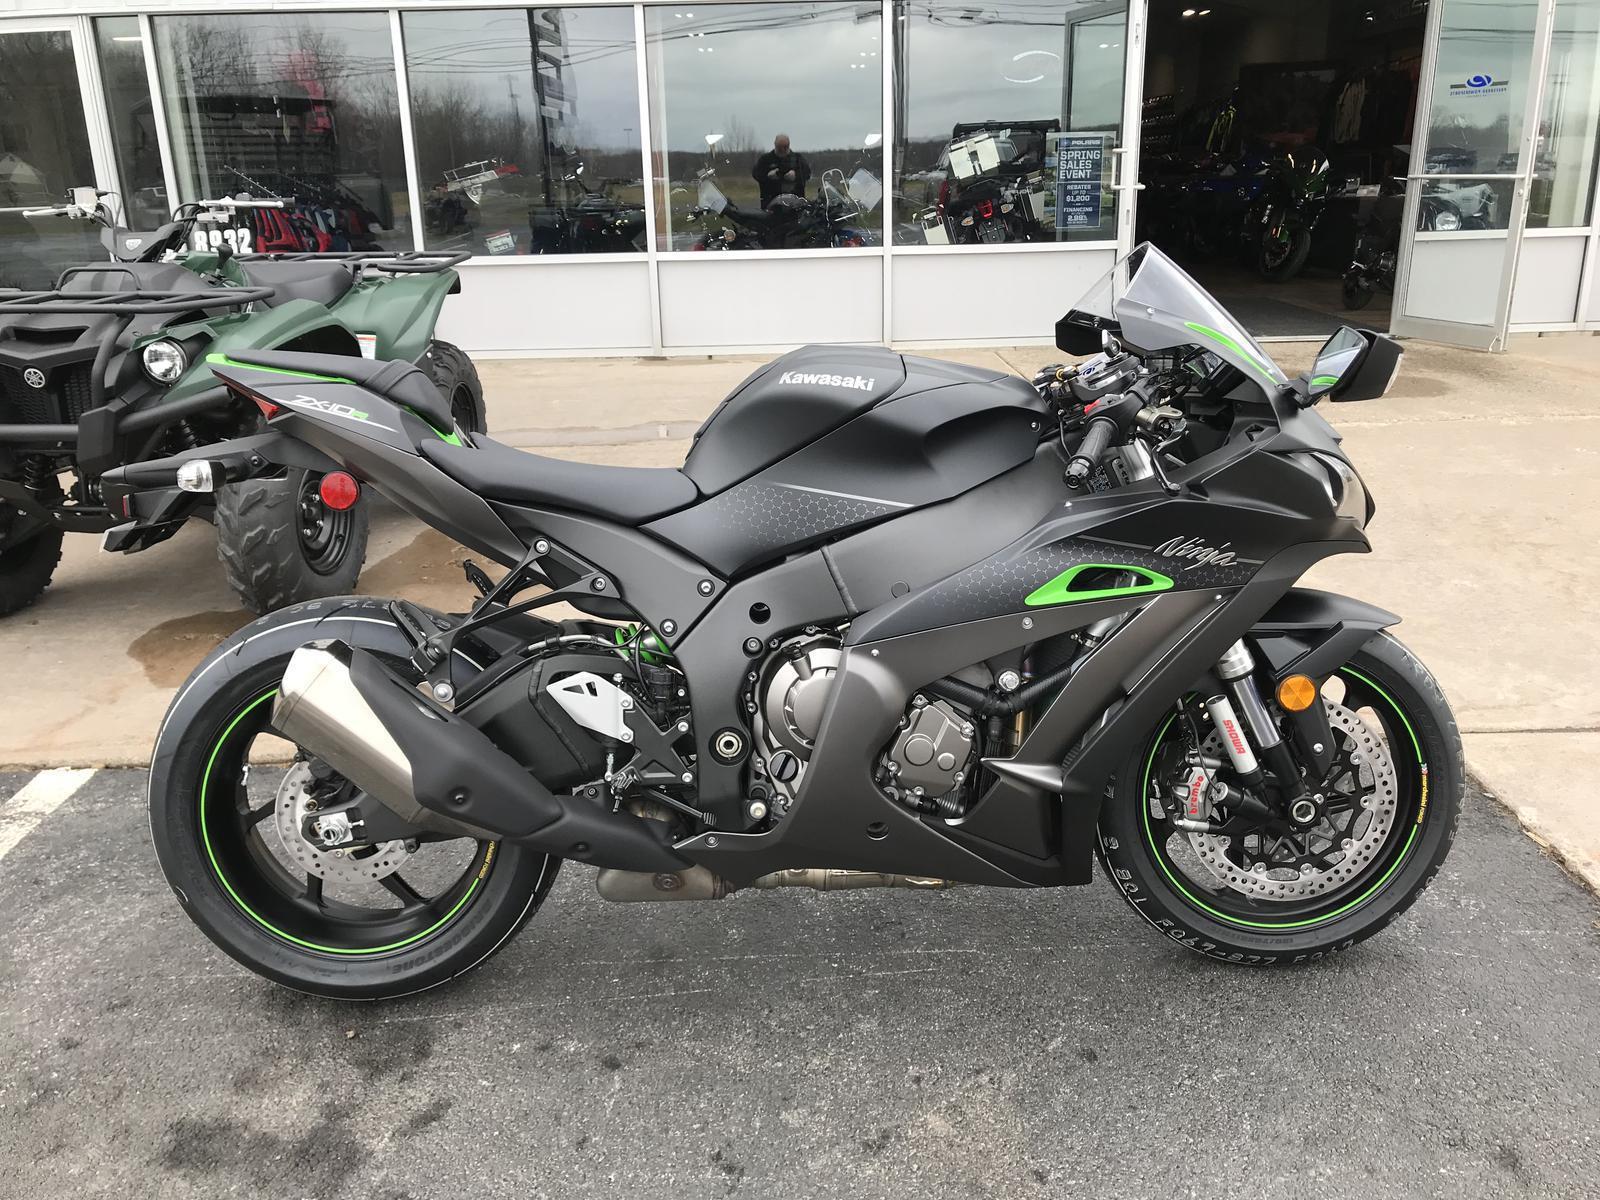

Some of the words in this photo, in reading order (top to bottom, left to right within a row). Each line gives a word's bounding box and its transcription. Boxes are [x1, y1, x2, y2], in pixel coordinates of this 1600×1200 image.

[1060, 150, 1101, 160] SPRING
[1060, 160, 1092, 170] SALES
[1060, 169, 1092, 179] EVENT
[779, 370, 876, 392] Kawasaki
[1153, 535, 1238, 571] Ninja
[1222, 719, 1247, 755] SHOWA
[1189, 775, 1205, 815] brembo
